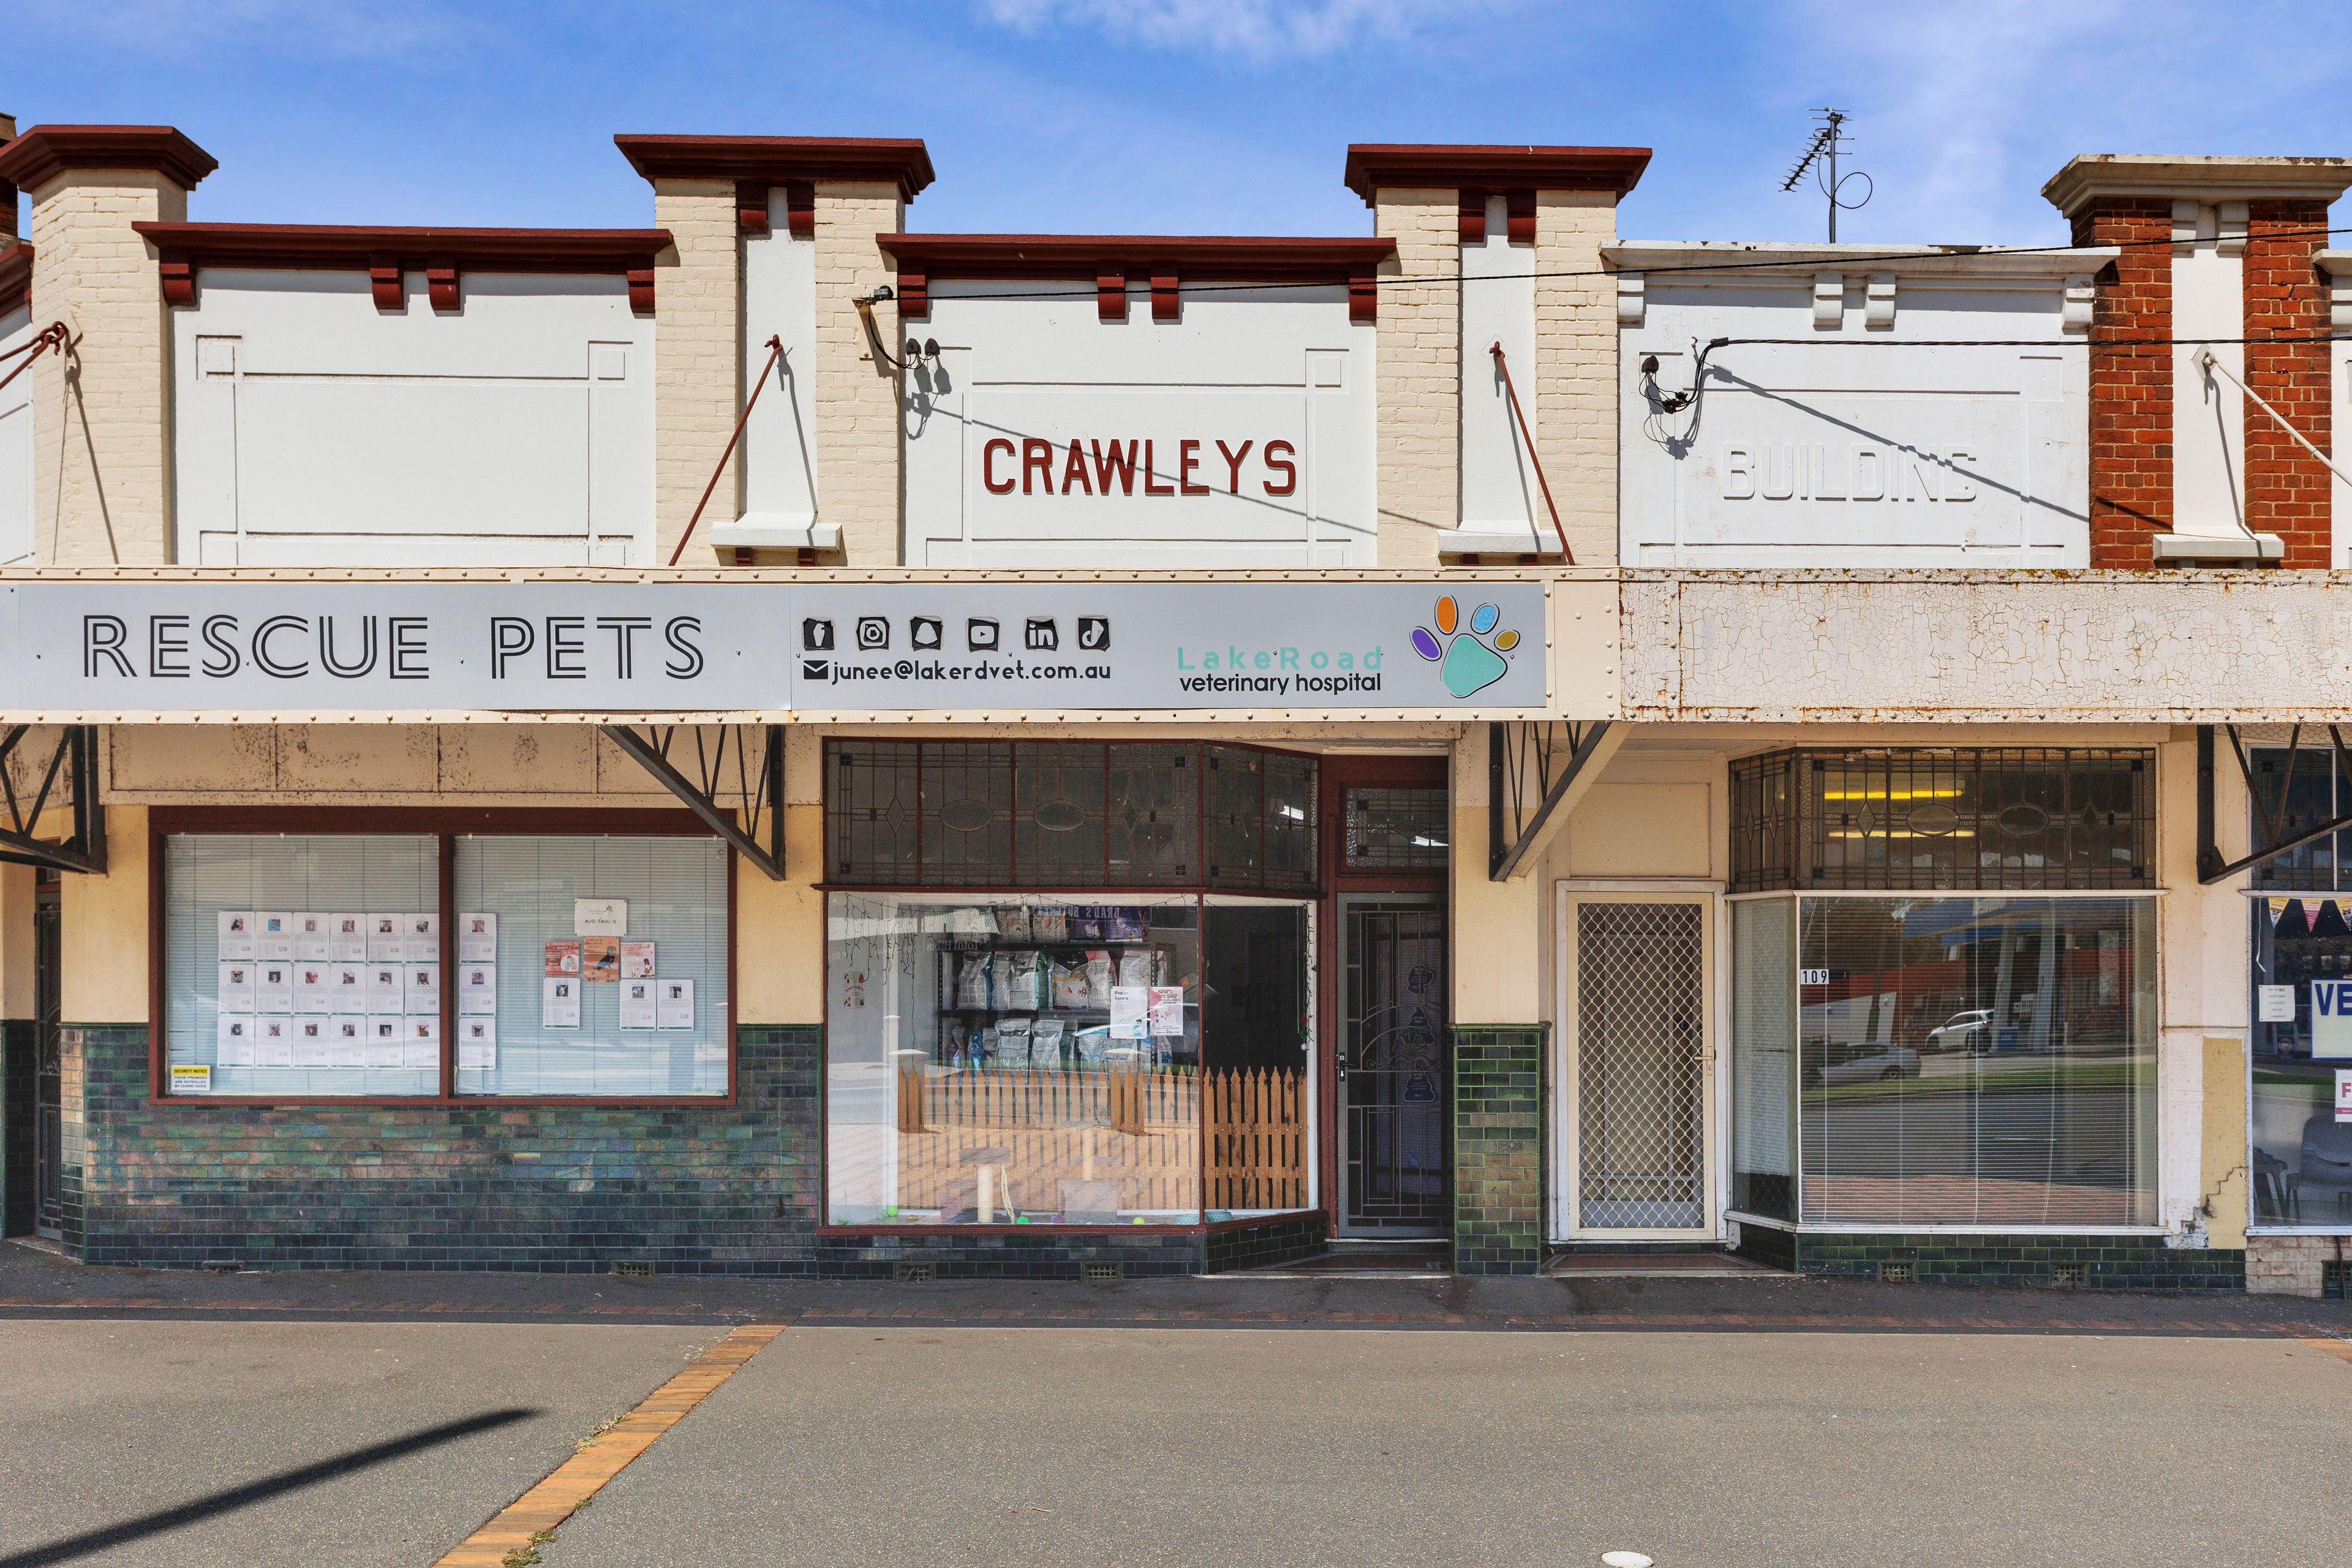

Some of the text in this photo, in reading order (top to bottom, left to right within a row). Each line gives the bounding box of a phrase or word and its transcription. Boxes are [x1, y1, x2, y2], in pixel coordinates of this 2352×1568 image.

[983, 438, 1297, 496] CRAWLEYS
[1722, 444, 1977, 502] BUILDING
[83, 614, 704, 680] RESCUE PETS
[832, 660, 1111, 685] junee@lakerdvet.com.au
[1180, 673, 1381, 695] veterinary hospital
[1803, 970, 1827, 983] 109
